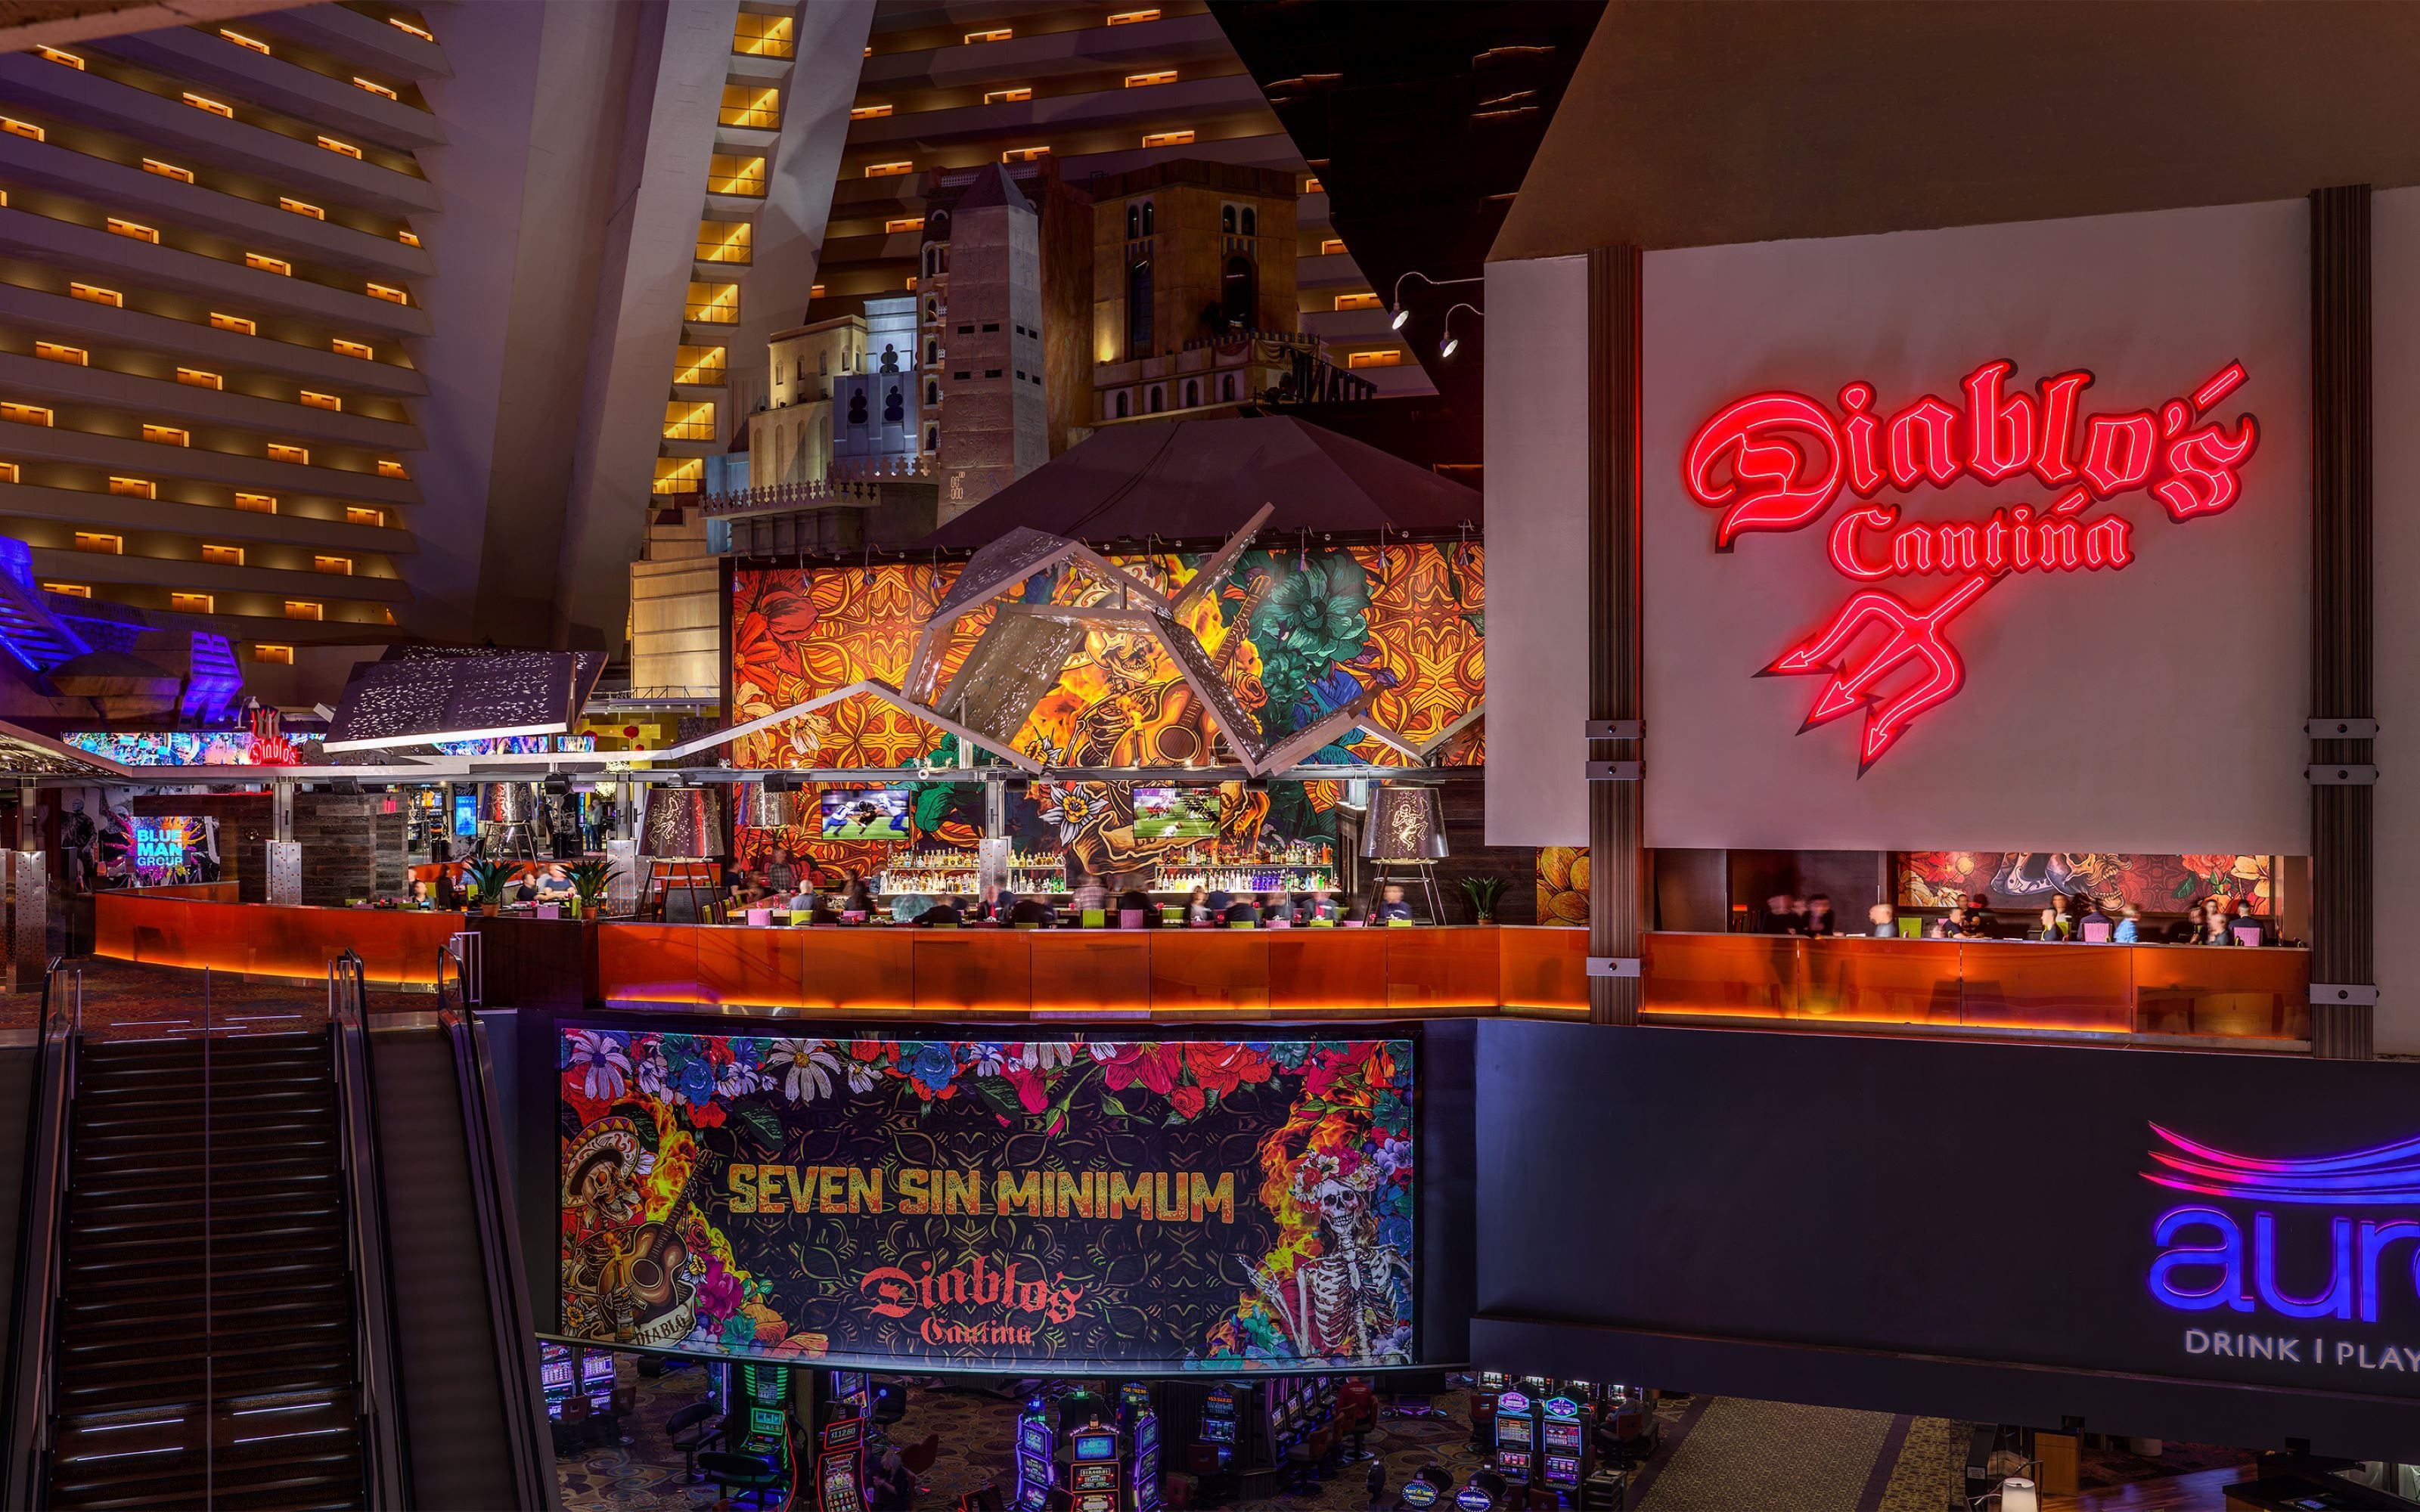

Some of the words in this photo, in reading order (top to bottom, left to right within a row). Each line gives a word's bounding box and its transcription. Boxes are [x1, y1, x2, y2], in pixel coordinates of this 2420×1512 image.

[1683, 358, 2260, 553] Diablo's
[1827, 503, 2135, 579] Cantina
[137, 829, 182, 842] BLUE
[137, 842, 182, 857] MAN
[137, 857, 183, 866] GROUP
[728, 1163, 883, 1214] SEVEN
[898, 1169, 981, 1216] SIN
[997, 1170, 1234, 1224] MINIMUM
[859, 1255, 1084, 1325] Diablo's
[2149, 1207, 2420, 1323] aur
[920, 1316, 1033, 1346] Cantina
[2185, 1330, 2301, 1363] DRINK
[2337, 1342, 2420, 1373] PLAY
